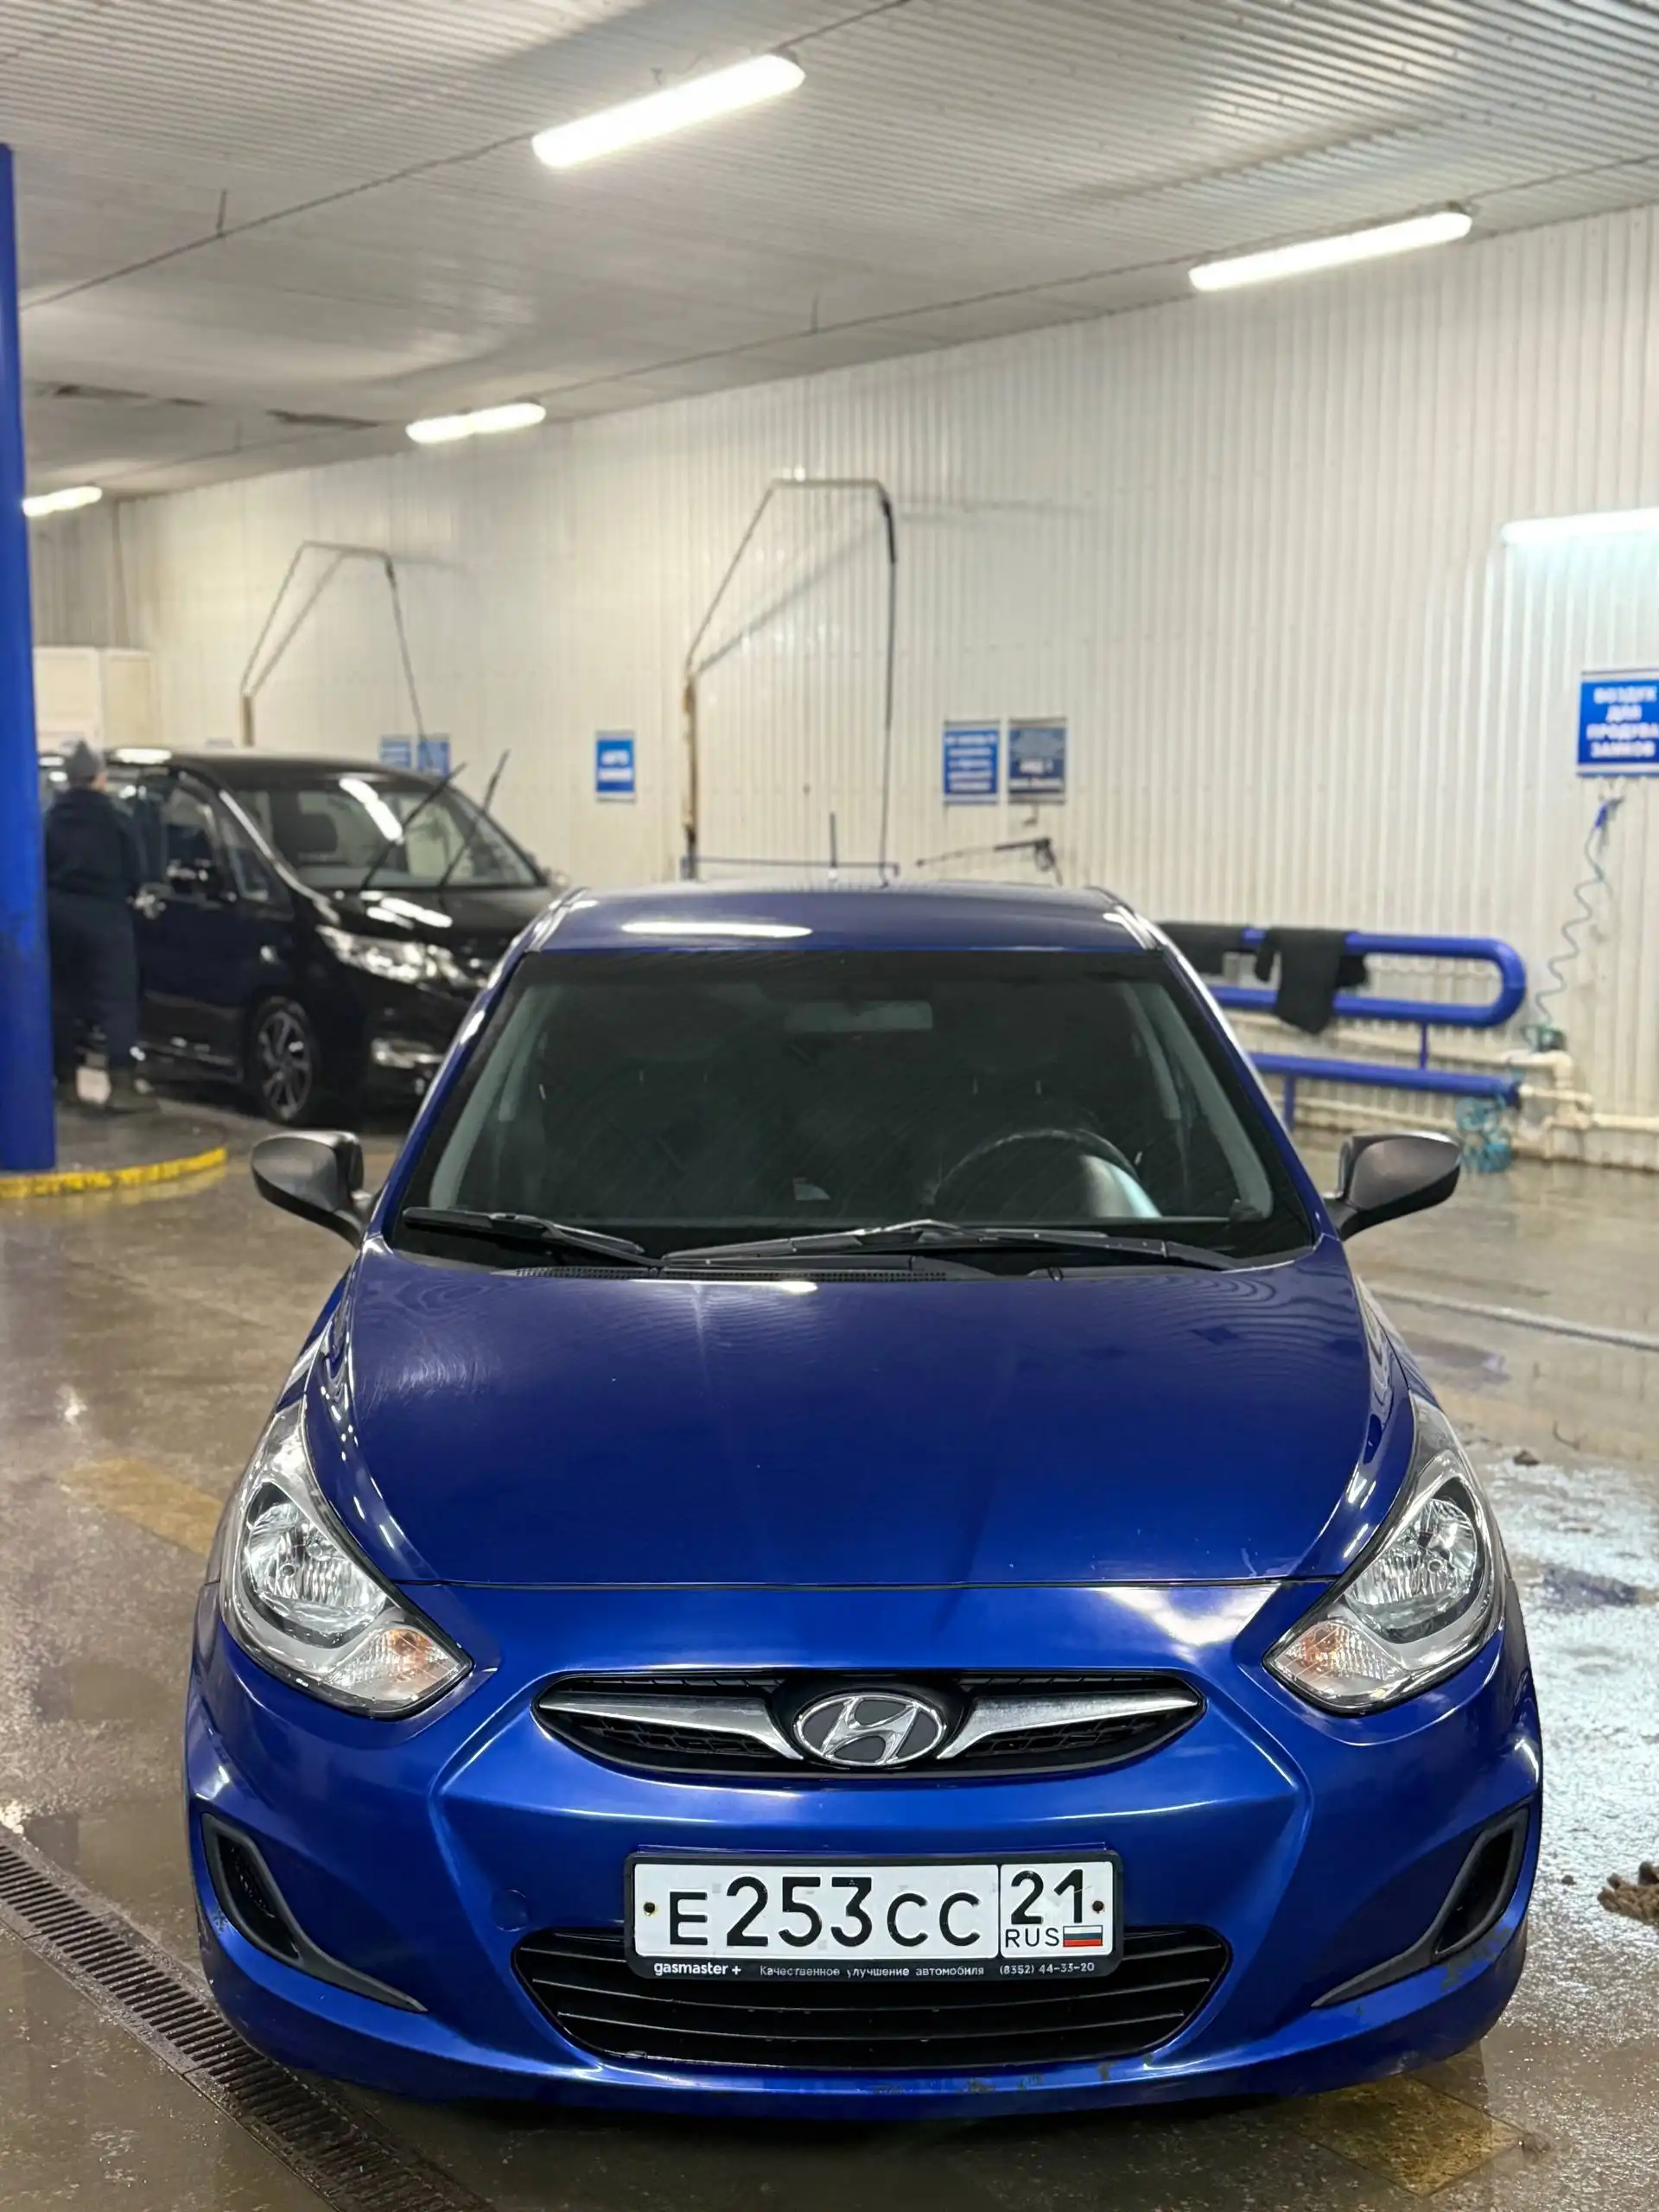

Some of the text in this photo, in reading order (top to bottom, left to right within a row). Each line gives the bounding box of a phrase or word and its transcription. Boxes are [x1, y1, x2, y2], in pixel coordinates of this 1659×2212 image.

[1010, 1868, 1084, 1925] 21
[1005, 1928, 1060, 1948] RUS
[653, 1961, 728, 1976] gasmaster
[760, 1961, 1096, 1979] Качественное улучшение автомобиля (8352) 44-33-20
